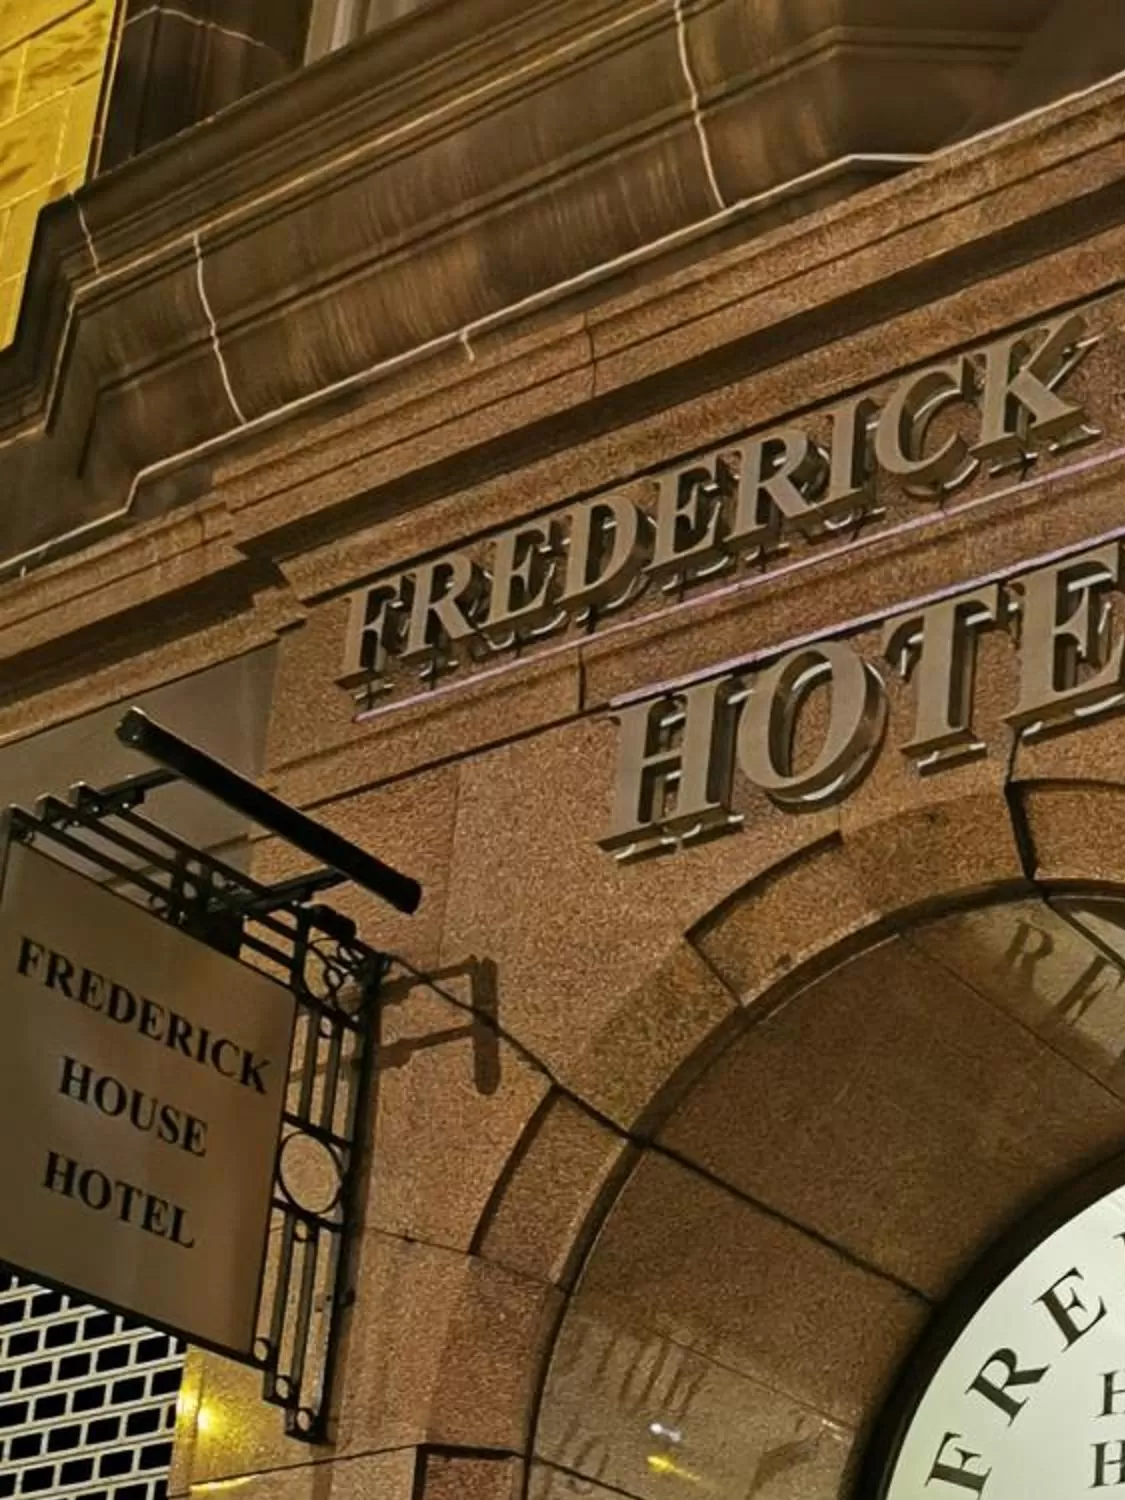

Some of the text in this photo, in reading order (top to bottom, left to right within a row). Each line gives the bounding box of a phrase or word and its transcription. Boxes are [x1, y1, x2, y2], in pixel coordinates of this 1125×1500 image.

[336, 337, 1104, 694] FREDERICK
[16, 936, 272, 1095] FREDERICK
[58, 1055, 209, 1158] HOUSE
[43, 1151, 195, 1249] HOTEL
